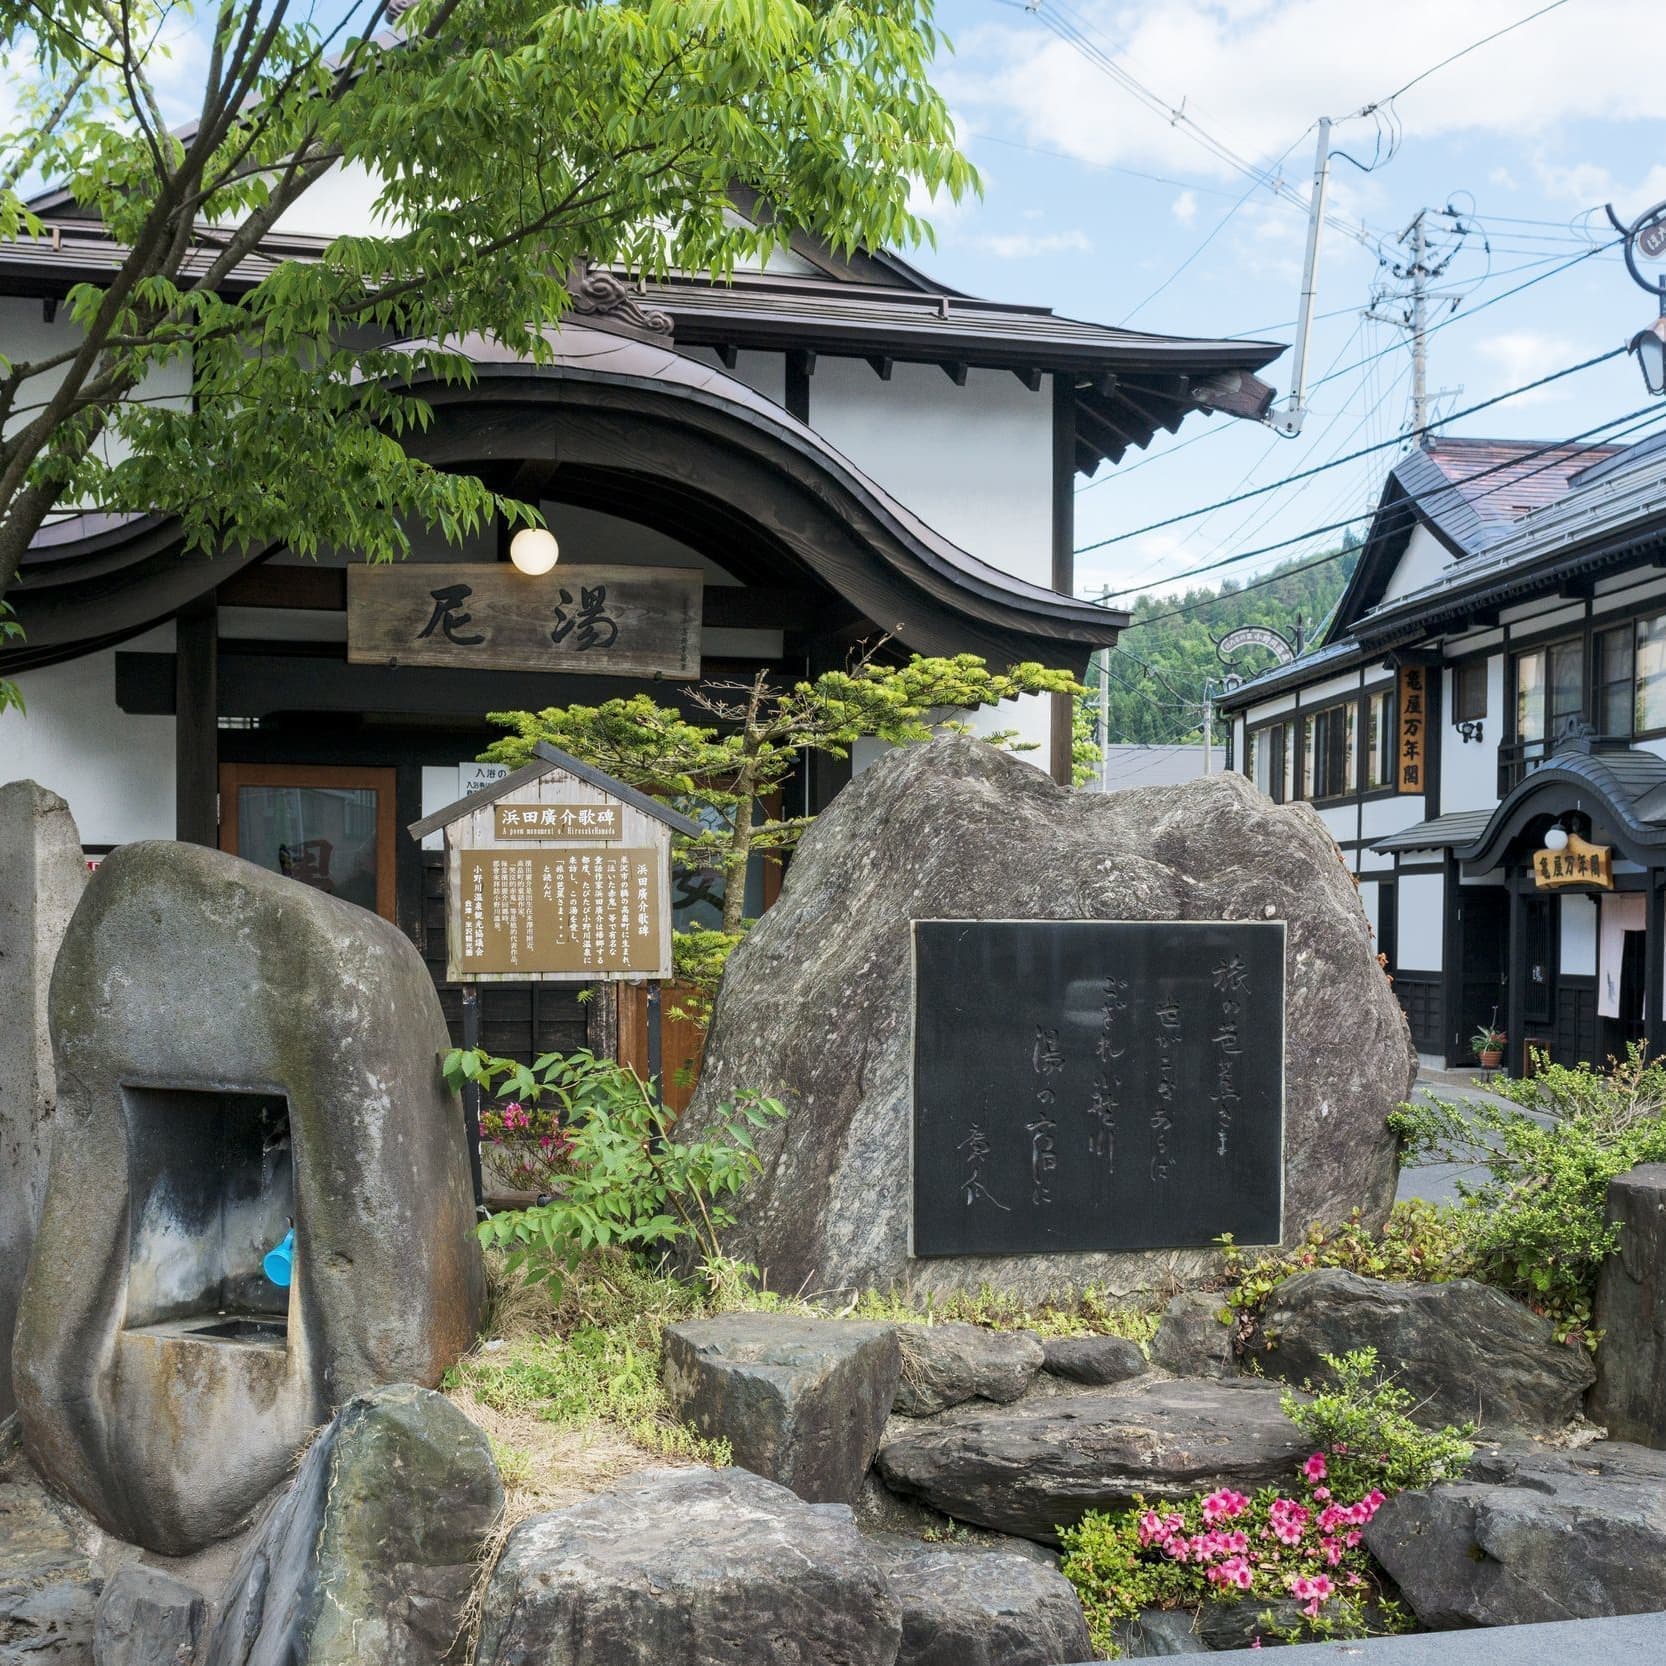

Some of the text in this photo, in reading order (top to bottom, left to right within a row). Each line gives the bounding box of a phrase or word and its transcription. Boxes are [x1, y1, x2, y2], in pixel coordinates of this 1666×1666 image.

[416, 583, 619, 651] 尼湯
[502, 808, 616, 826] 浜田廣介歌碑
